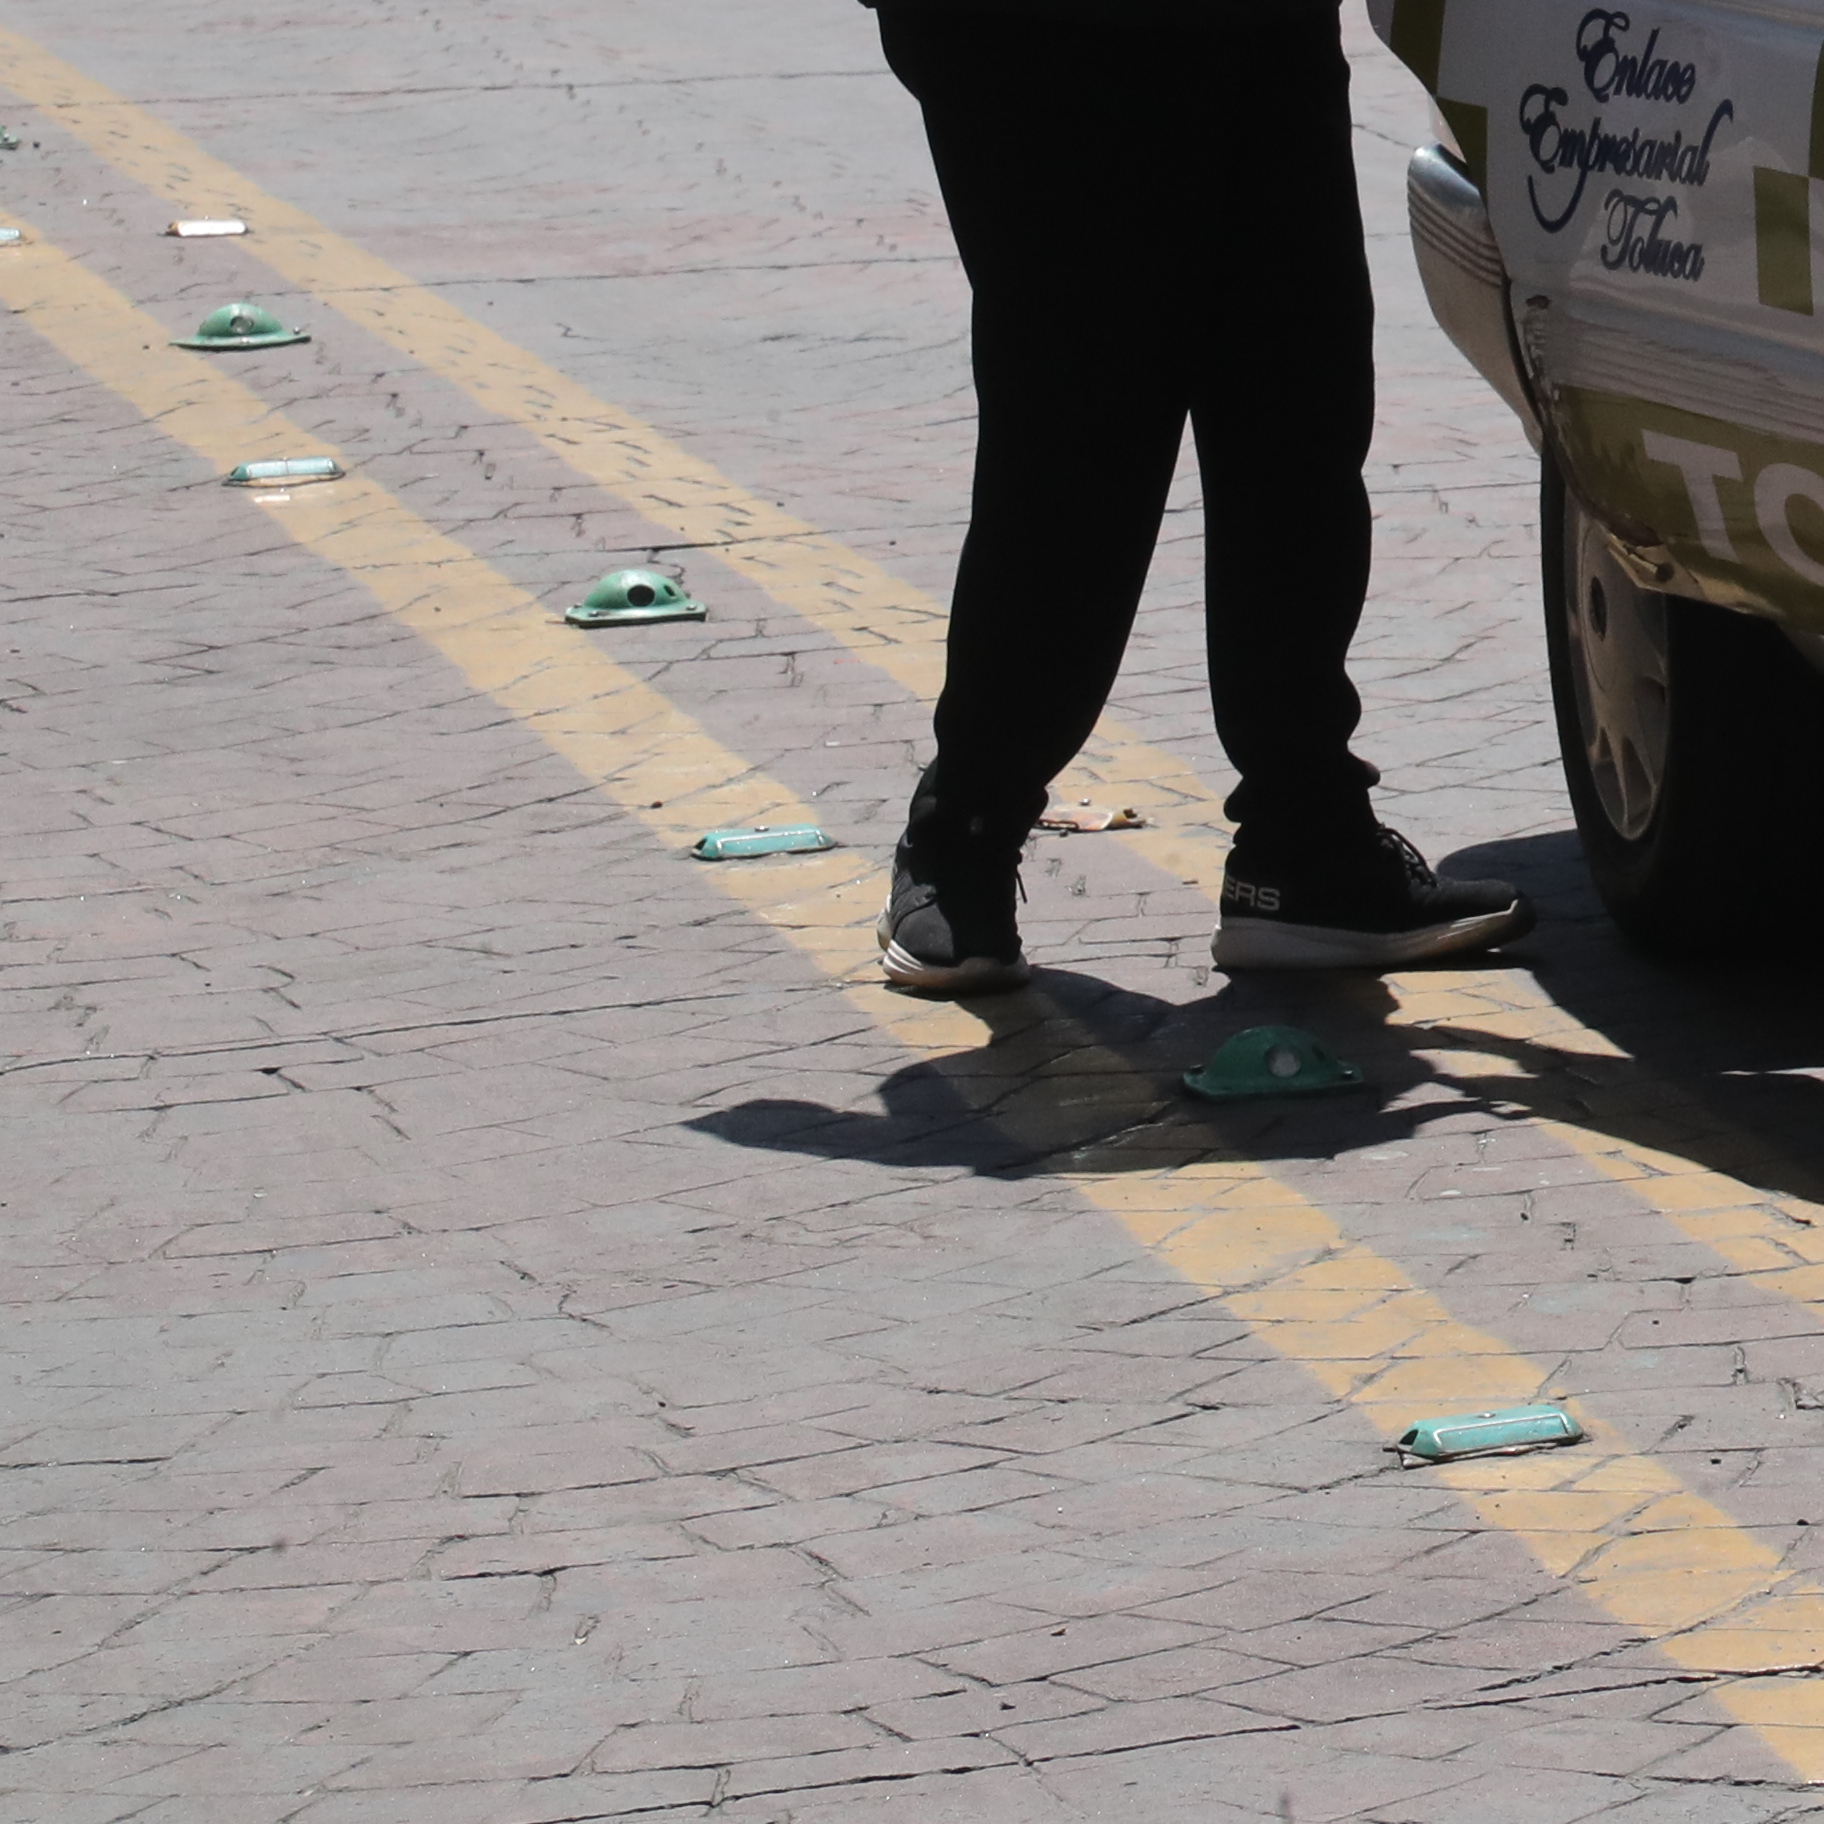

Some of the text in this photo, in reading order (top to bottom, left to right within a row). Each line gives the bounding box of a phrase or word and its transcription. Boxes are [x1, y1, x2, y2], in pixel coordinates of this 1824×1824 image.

[1575, 8, 1696, 104] Enlace
[1519, 83, 1734, 234] Empresarial
[1600, 188, 1705, 282] Toluca
